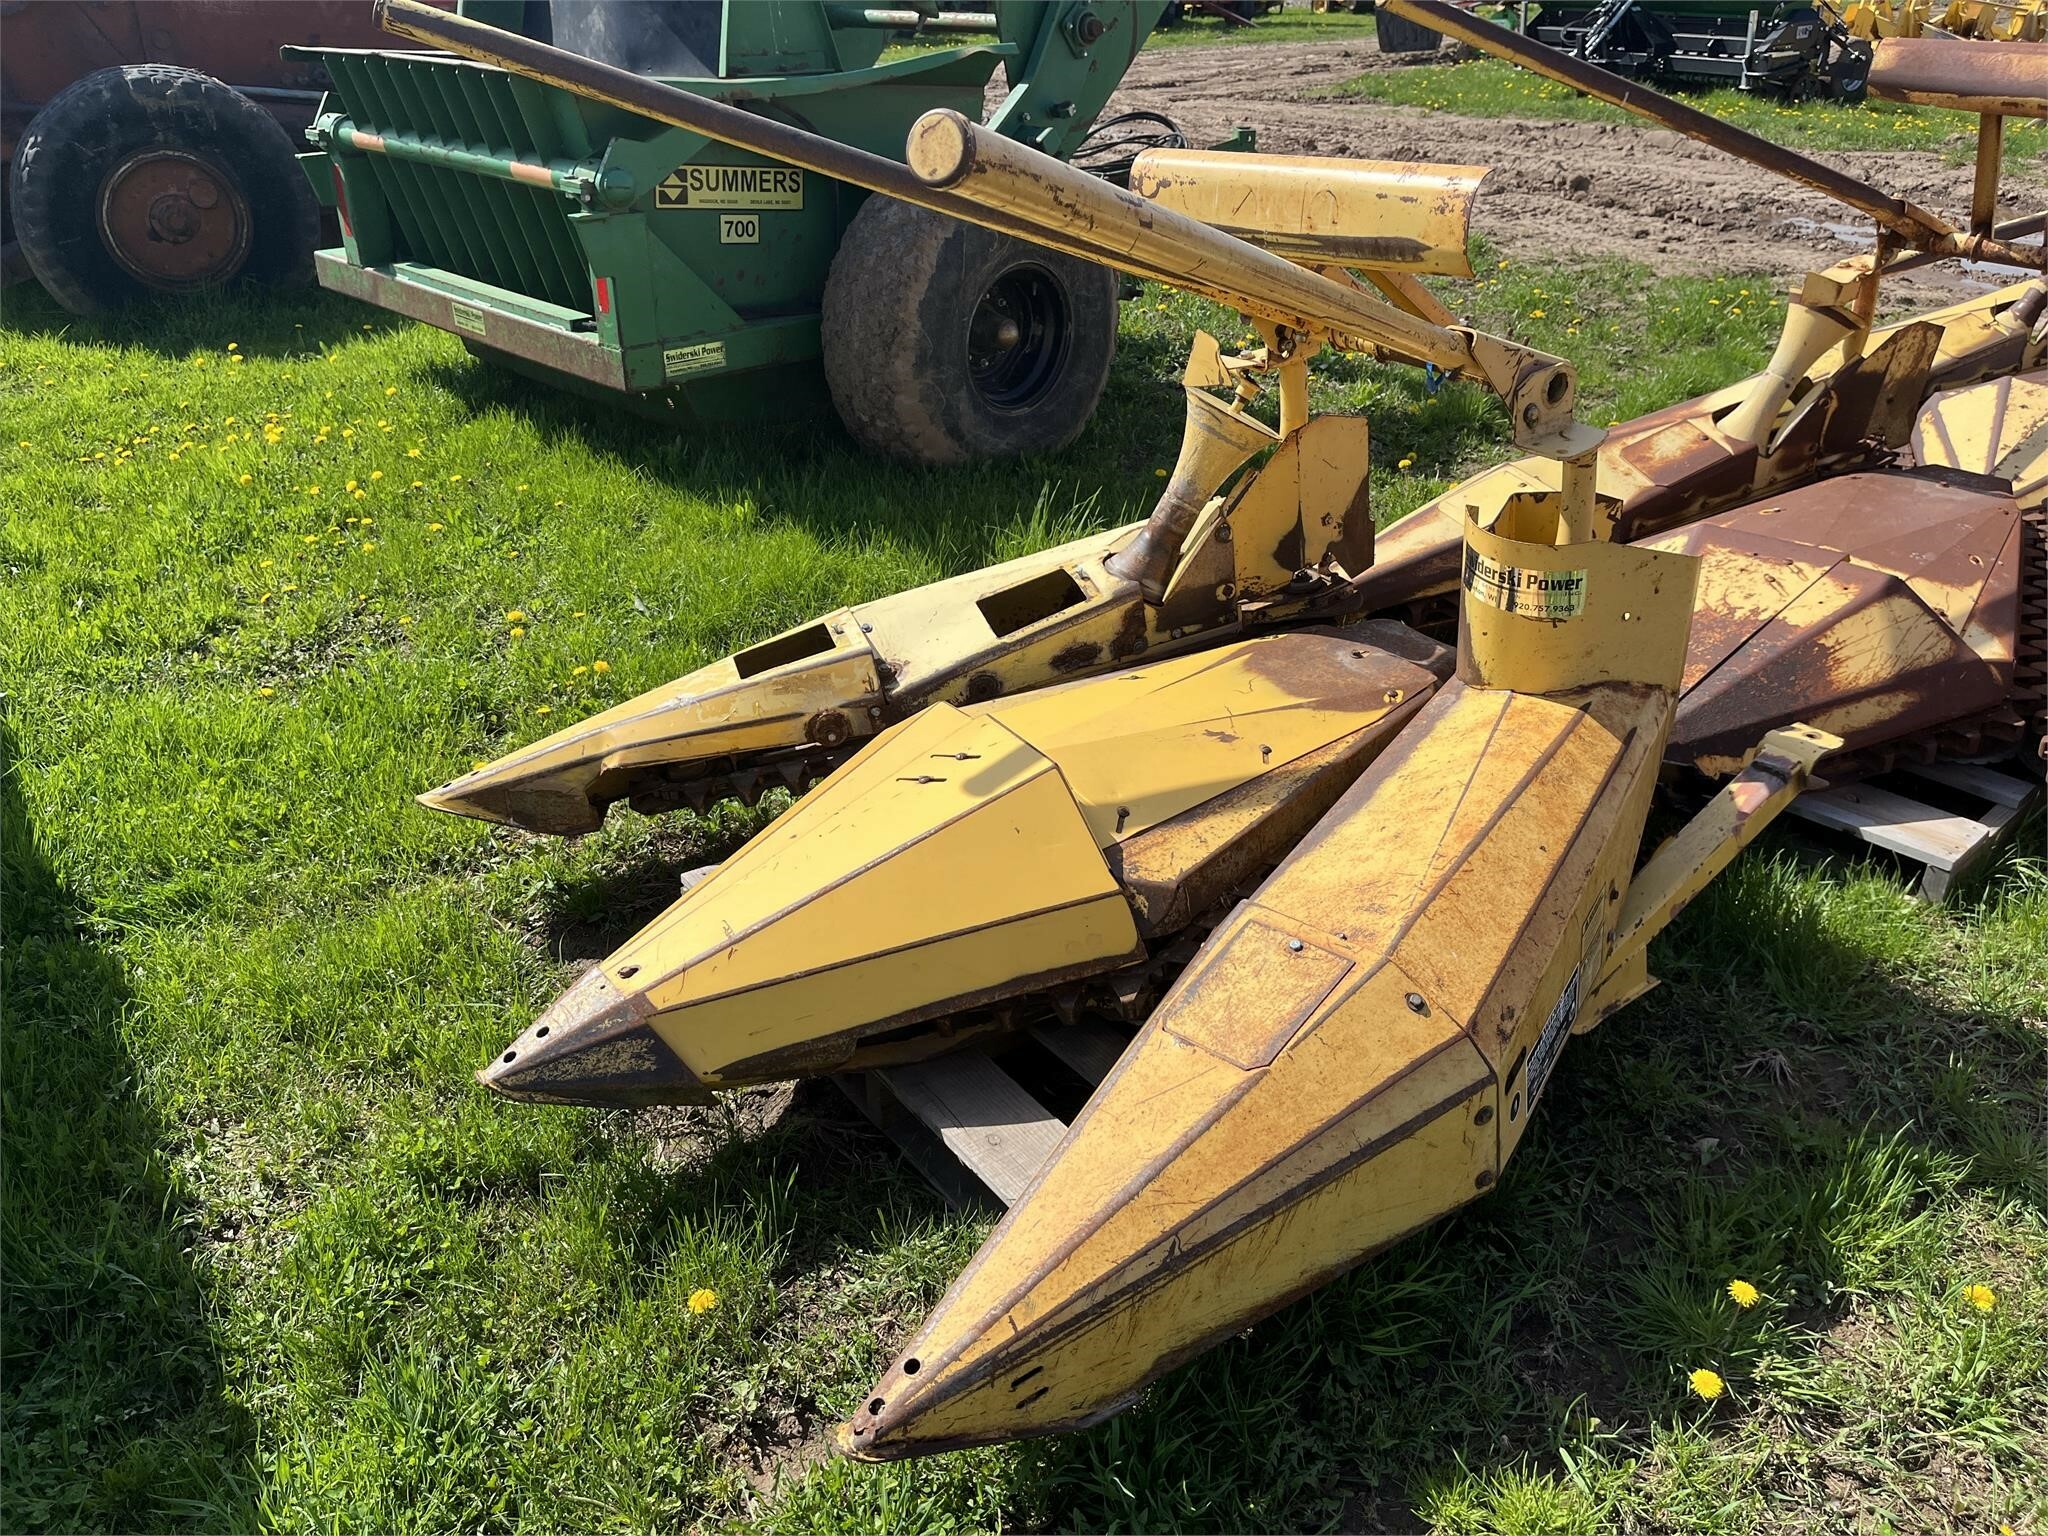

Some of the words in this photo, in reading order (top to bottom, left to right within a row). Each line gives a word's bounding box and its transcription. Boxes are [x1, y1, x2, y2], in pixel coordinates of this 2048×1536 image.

[690, 168, 800, 193] SUMMERS
[724, 220, 755, 238] 700
[702, 345, 724, 356] Power
[1465, 550, 1522, 588] iderski
[1526, 574, 1583, 592] Power
[1514, 601, 1575, 613] 920.757.9363
